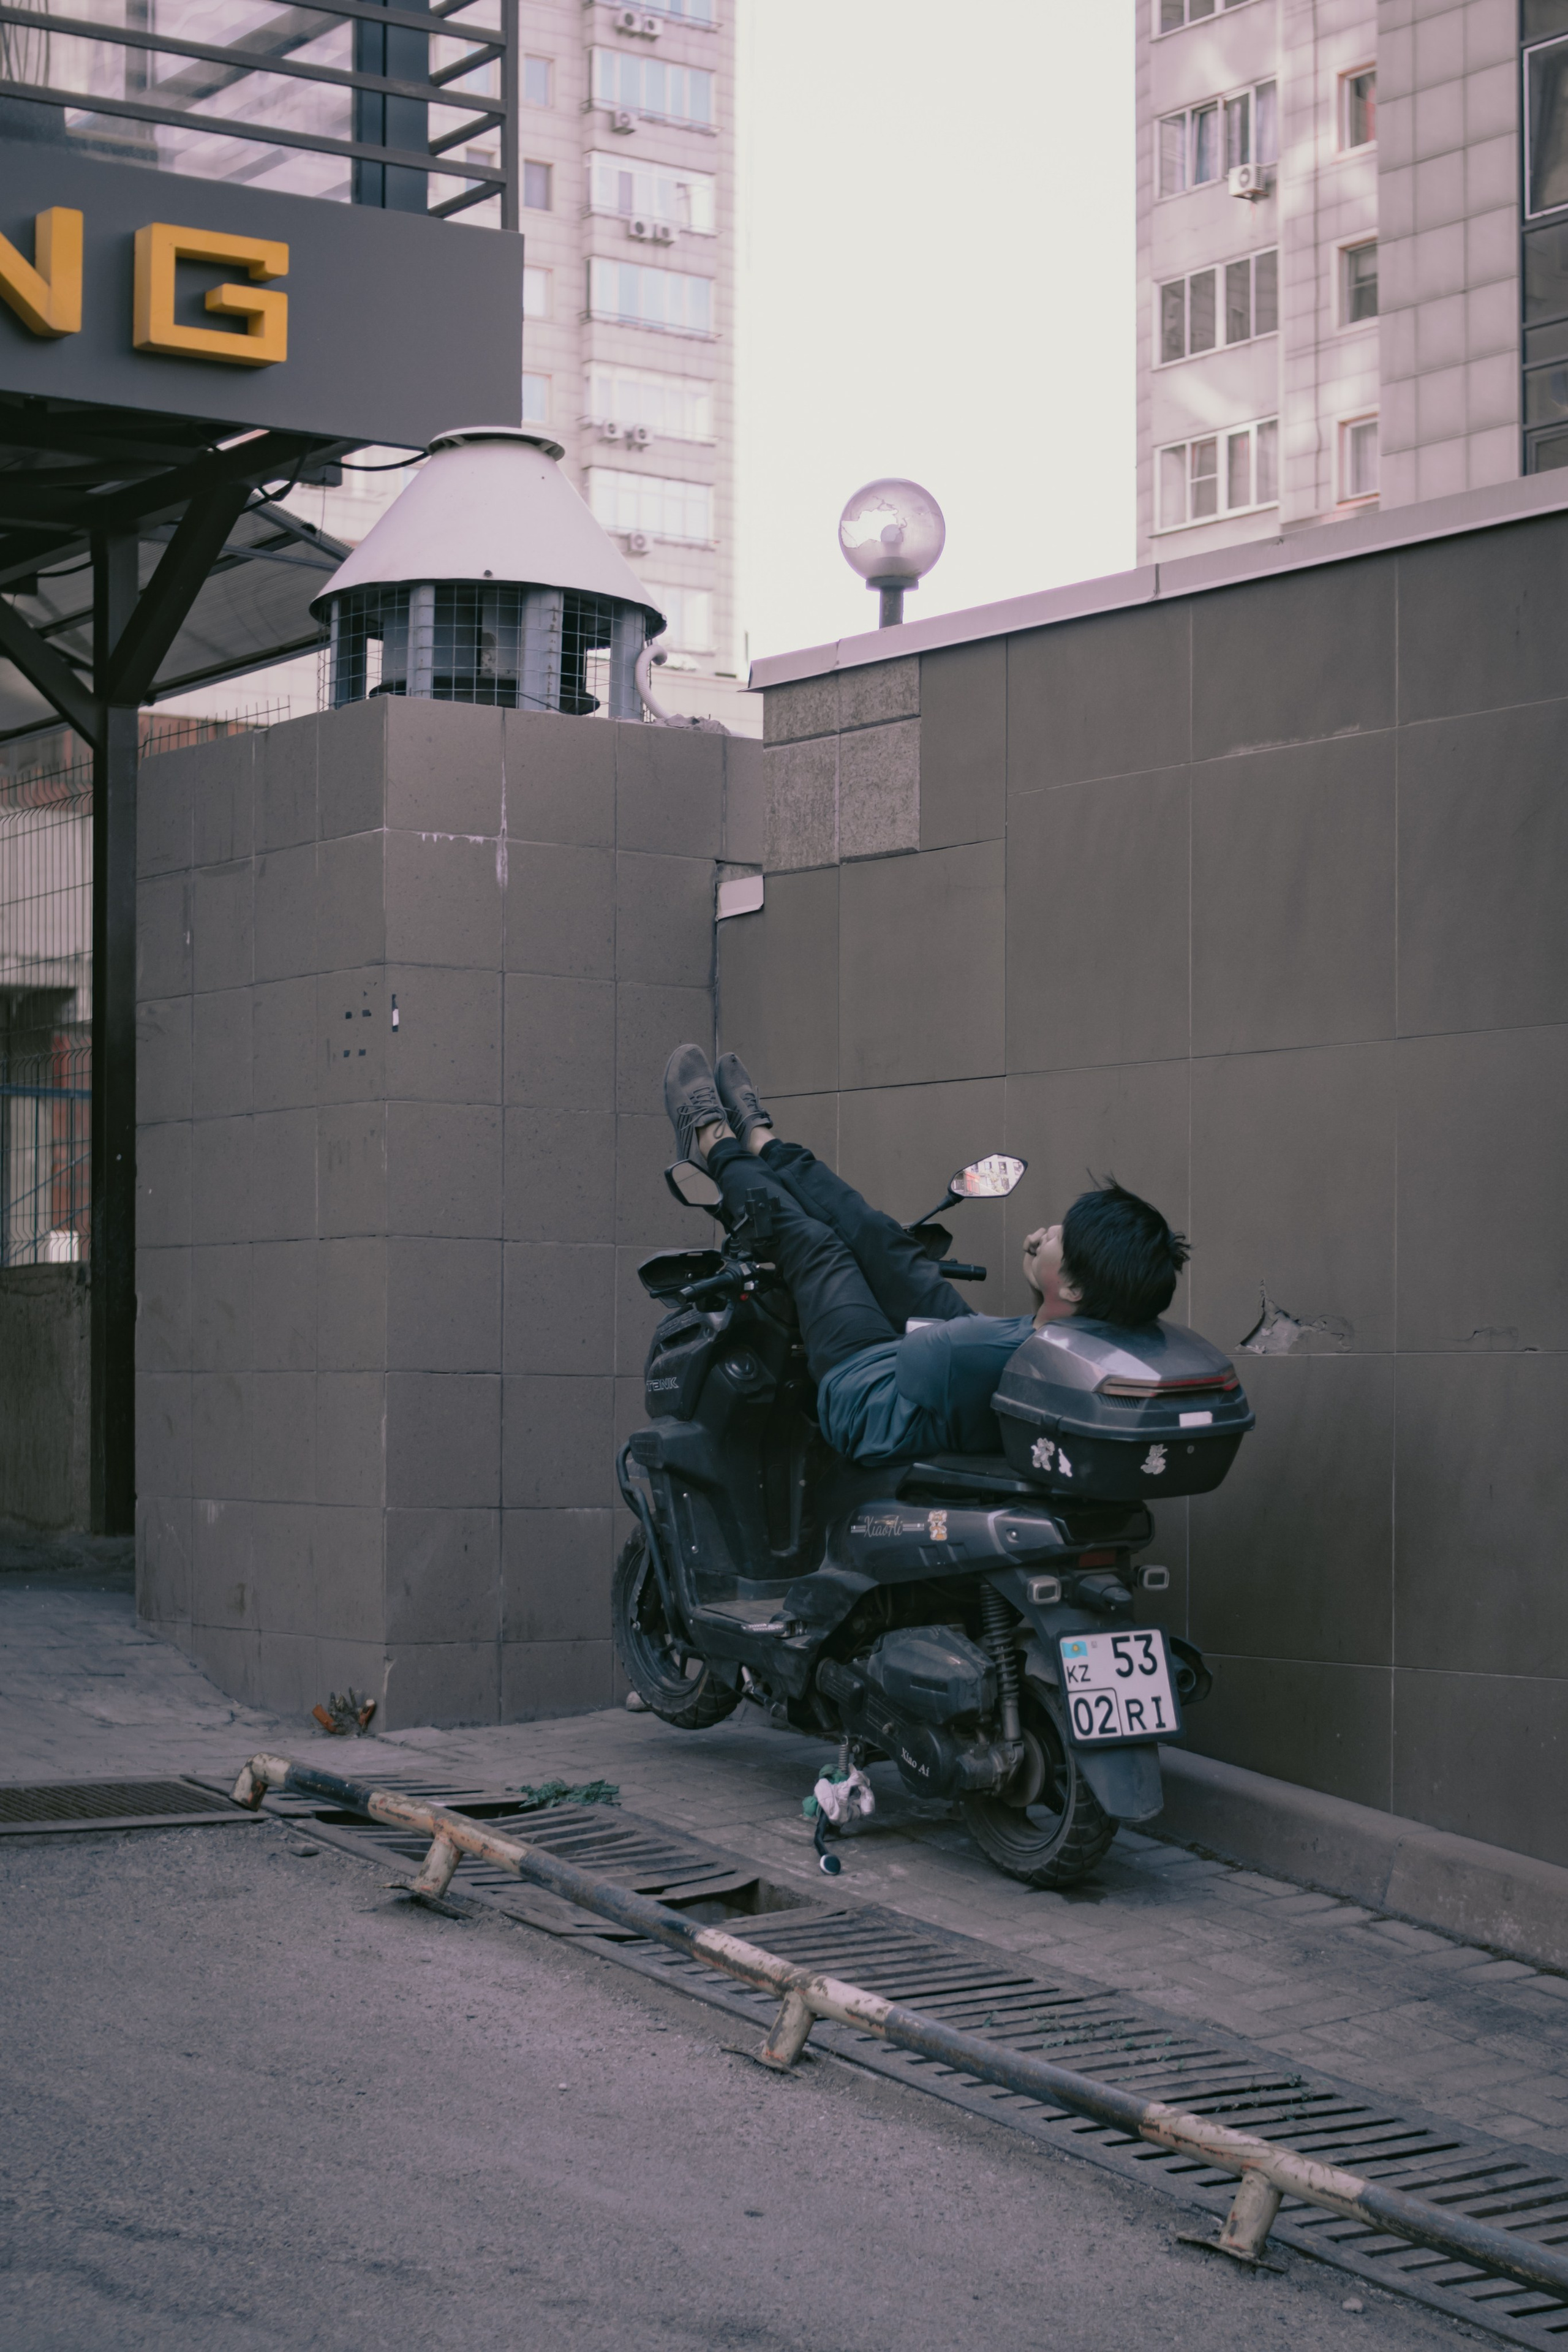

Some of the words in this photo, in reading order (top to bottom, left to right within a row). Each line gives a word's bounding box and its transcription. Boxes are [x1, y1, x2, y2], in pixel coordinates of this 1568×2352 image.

[1066, 1664, 1091, 1683] KZ
[1110, 1634, 1158, 1678] 53
[1074, 1695, 1117, 1736] 02
[1125, 1696, 1166, 1732] RI
